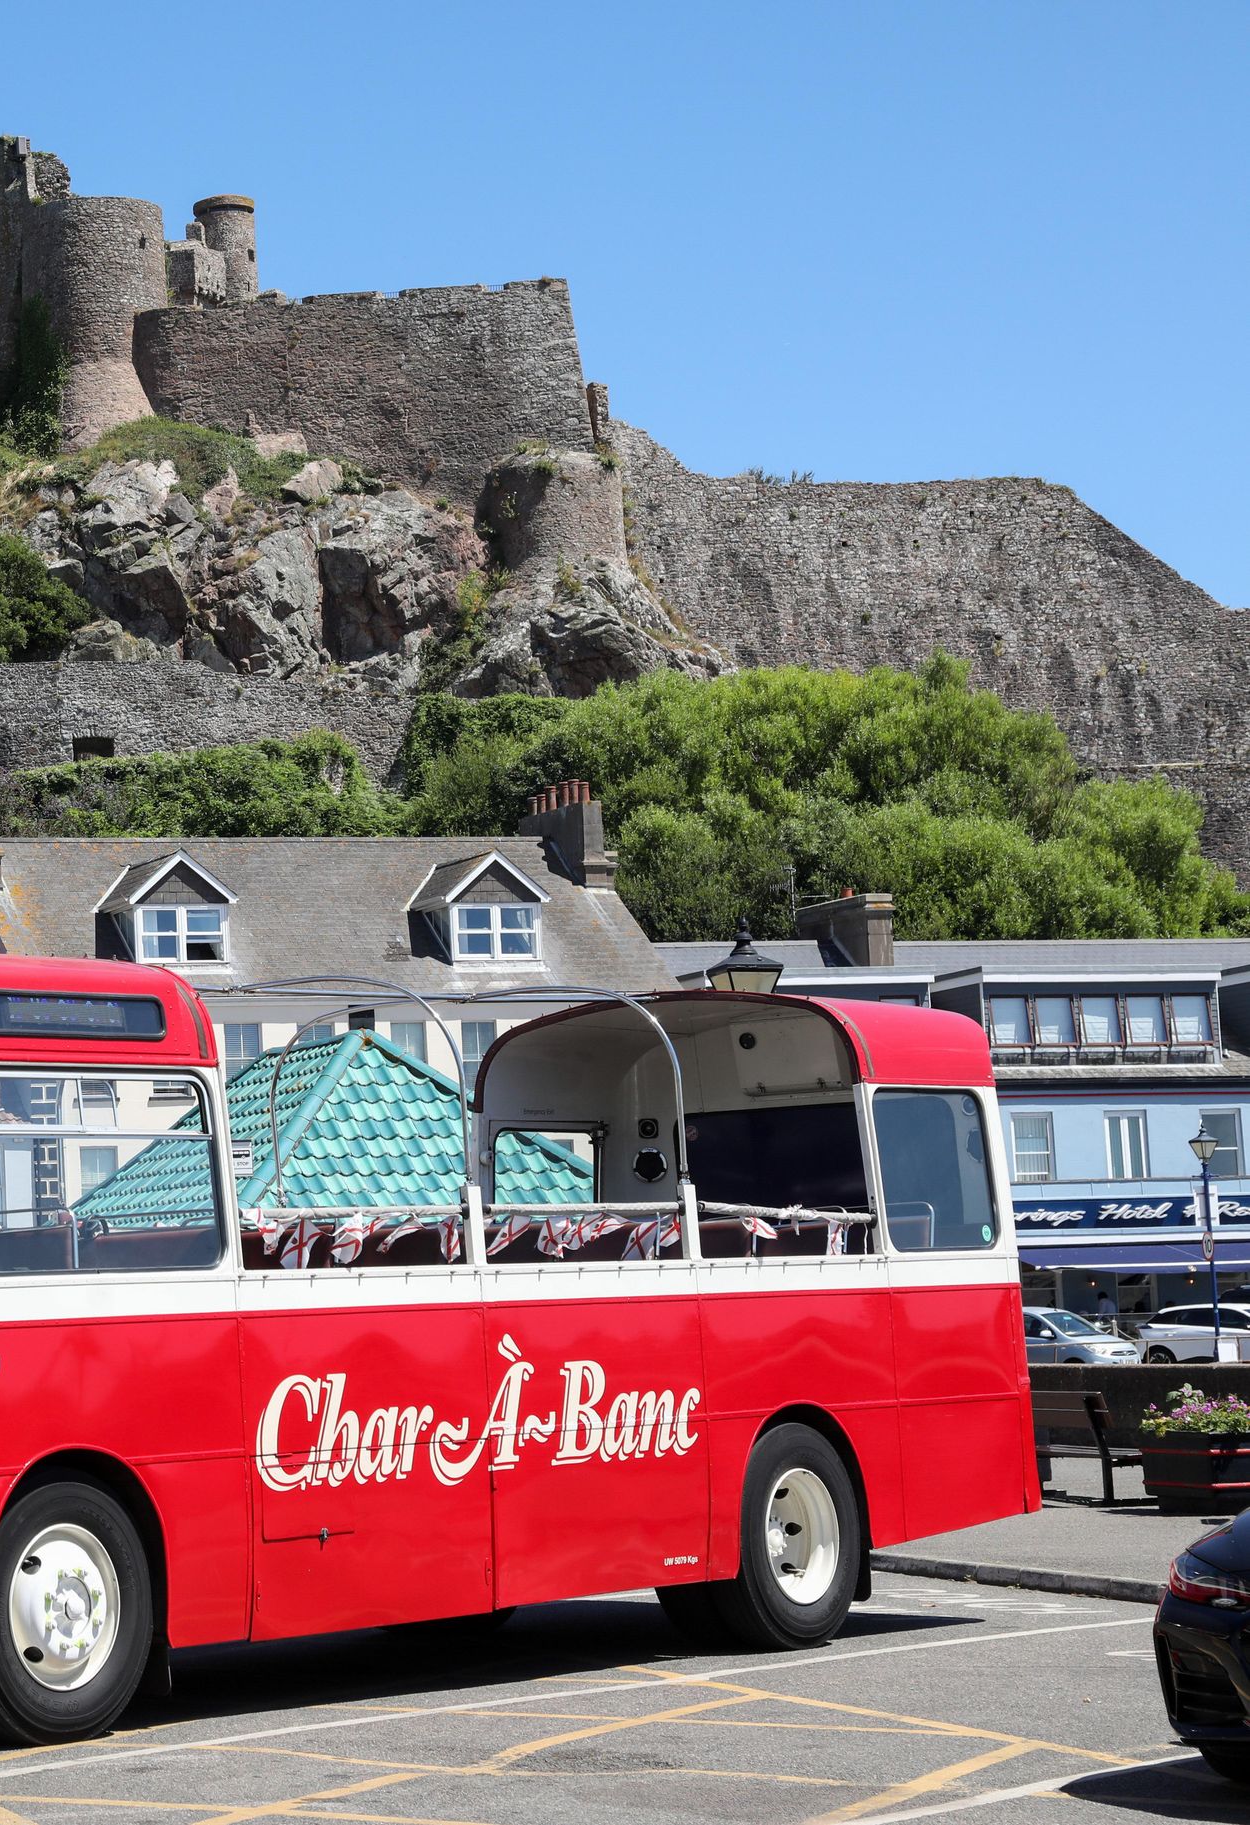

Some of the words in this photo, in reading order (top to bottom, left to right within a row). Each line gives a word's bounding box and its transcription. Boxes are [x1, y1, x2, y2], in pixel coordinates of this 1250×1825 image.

[1098, 1202, 1174, 1221] Hotel
[1203, 1238, 1213, 1254] 10
[687, 1555, 699, 1565] Kgs
